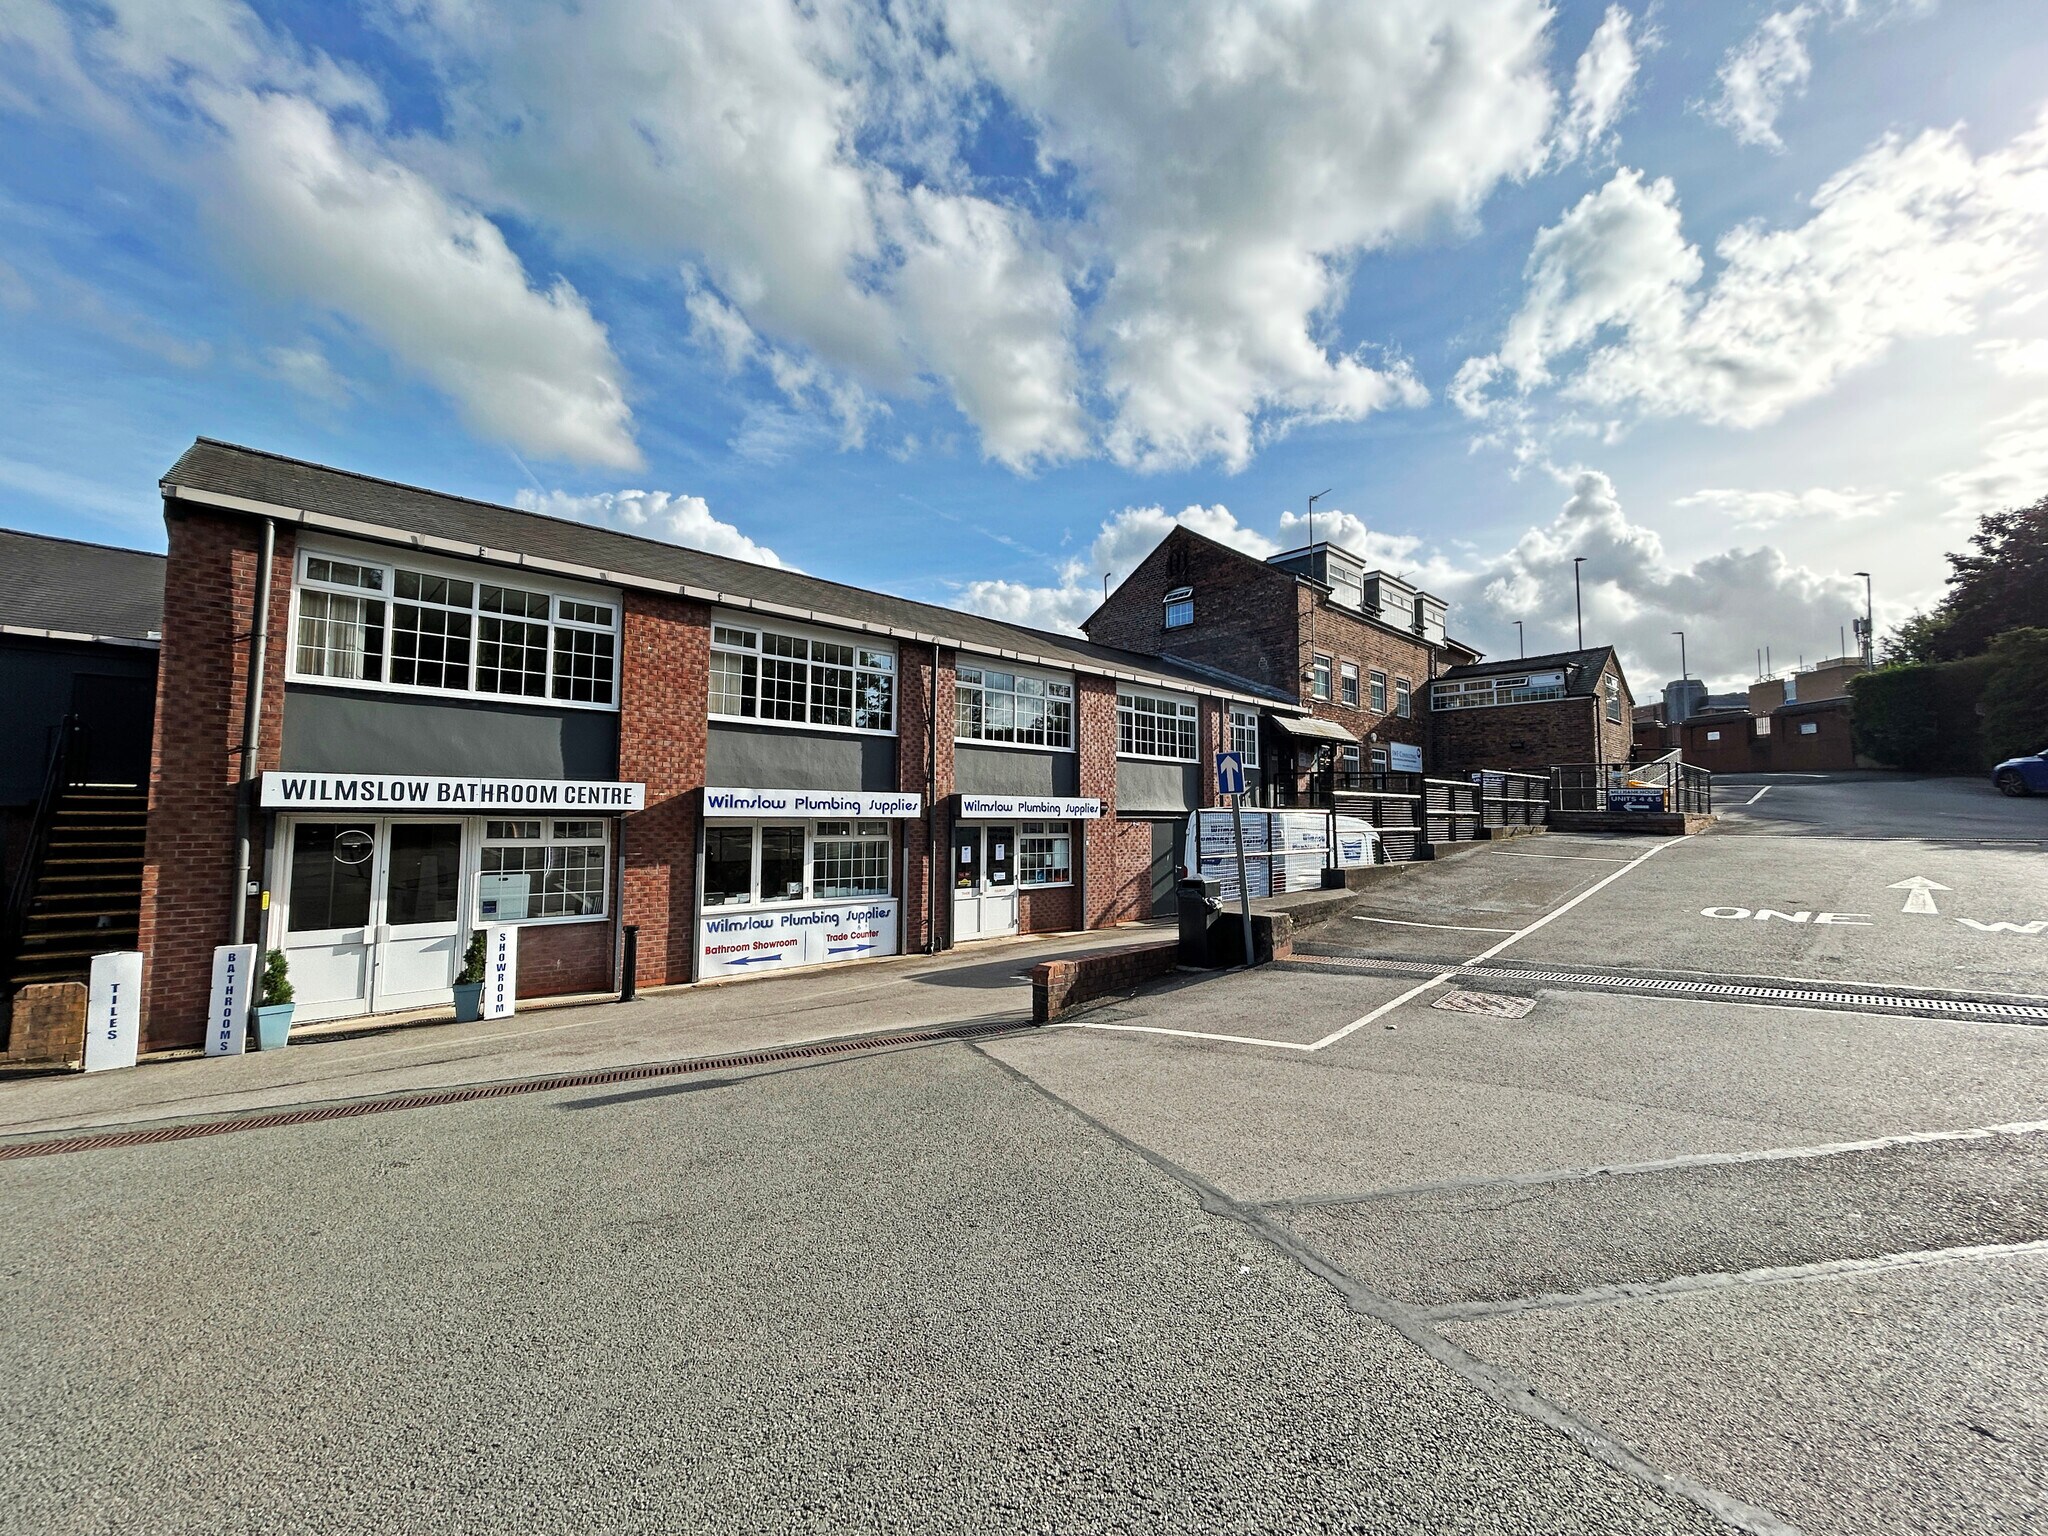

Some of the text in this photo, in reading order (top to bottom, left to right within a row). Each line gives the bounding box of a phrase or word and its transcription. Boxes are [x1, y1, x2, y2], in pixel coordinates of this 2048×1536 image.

[282, 778, 633, 805] WILMSLOW BATHROOM CENTRE
[707, 794, 918, 815] Wilmslow Plumbing Supplies
[963, 799, 1098, 817] Wilmslow Plumbing Supplies
[706, 906, 891, 934] Wilmslow Plumbing Supplies
[1700, 906, 1874, 926] ONE
[705, 938, 798, 956] Bathroom Showroom
[826, 929, 880, 943] Trade Counter
[495, 933, 507, 1013] SHOWROOM
[107, 983, 121, 1040] TILES
[219, 953, 237, 1051] BATHROOMS
